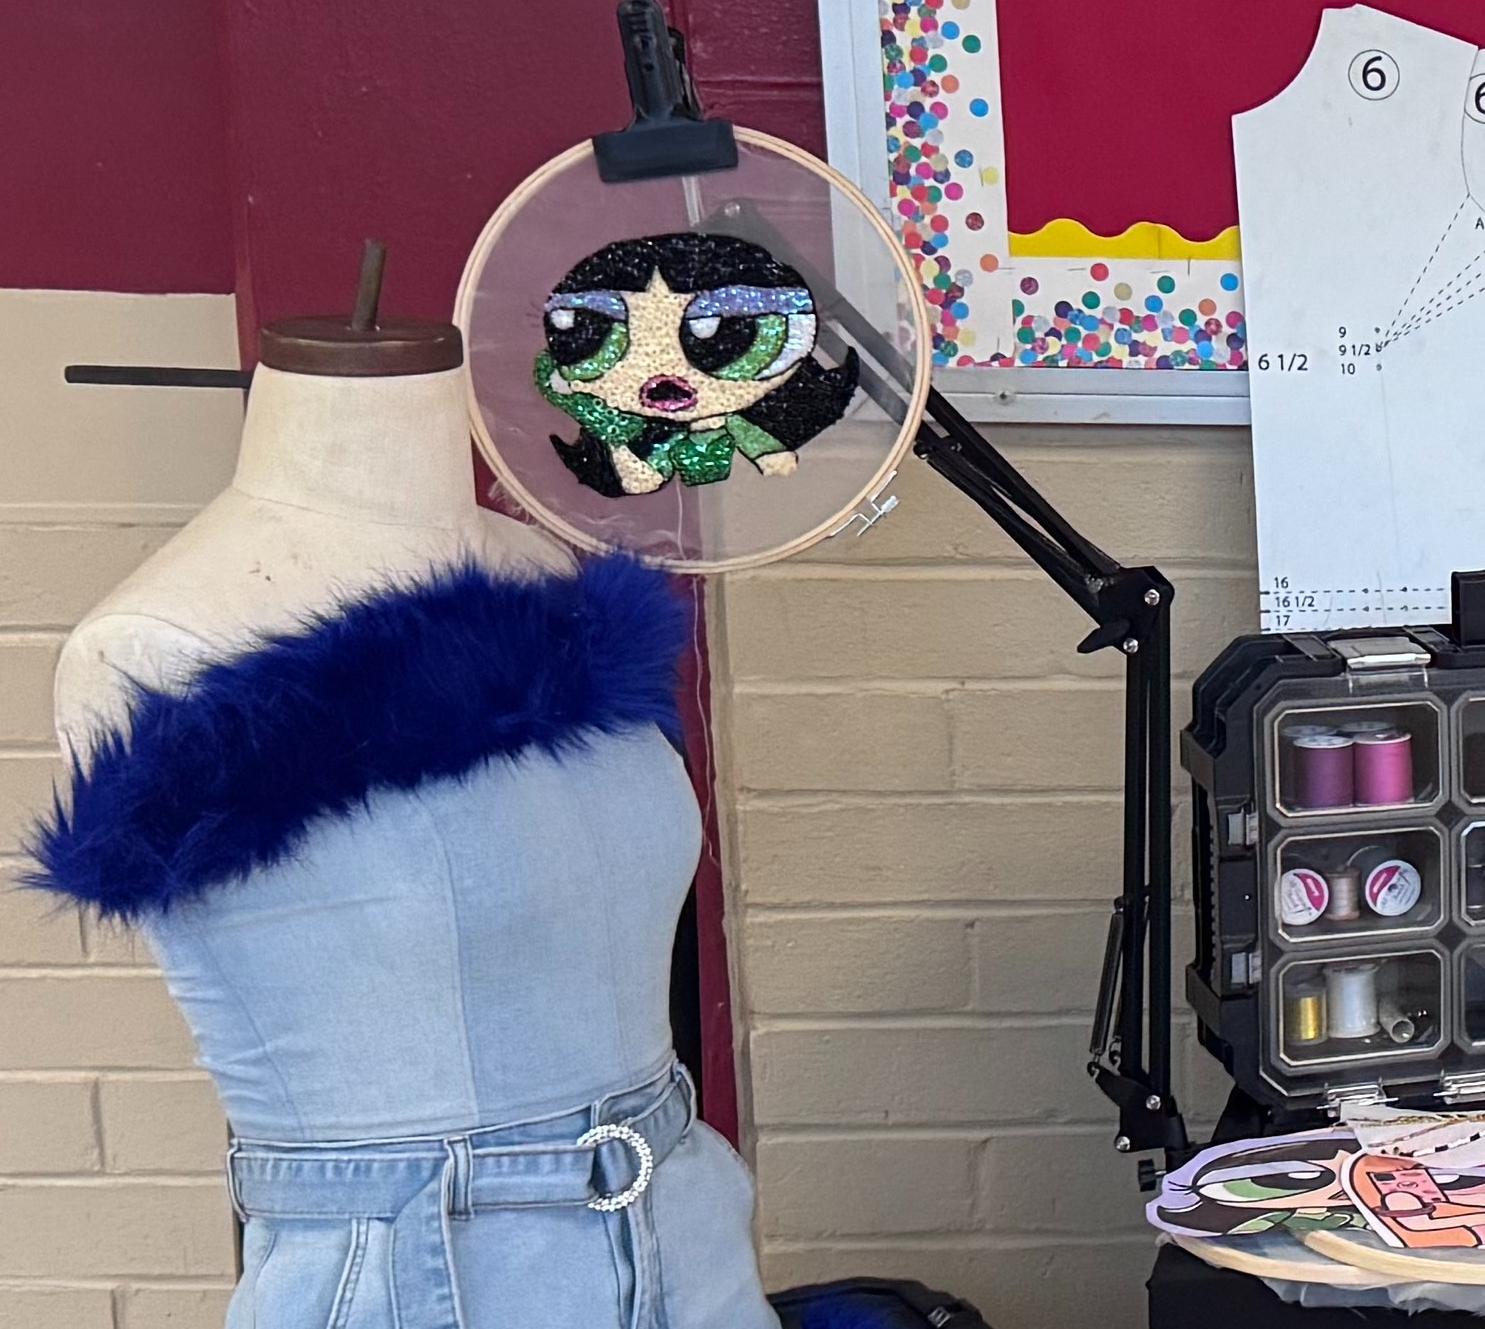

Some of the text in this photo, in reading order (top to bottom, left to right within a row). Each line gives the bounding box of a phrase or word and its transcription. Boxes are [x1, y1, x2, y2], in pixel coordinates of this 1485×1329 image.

[1361, 55, 1386, 92] 6
[1475, 217, 1485, 232] A
[1338, 325, 1347, 341] 9
[1338, 343, 1371, 358] 9 1/2
[1257, 352, 1310, 373] 6 1/2
[1339, 363, 1356, 376] 10
[1274, 576, 1289, 589] 16
[1274, 595, 1316, 610] 16 1/2
[1275, 615, 1290, 628] 17
